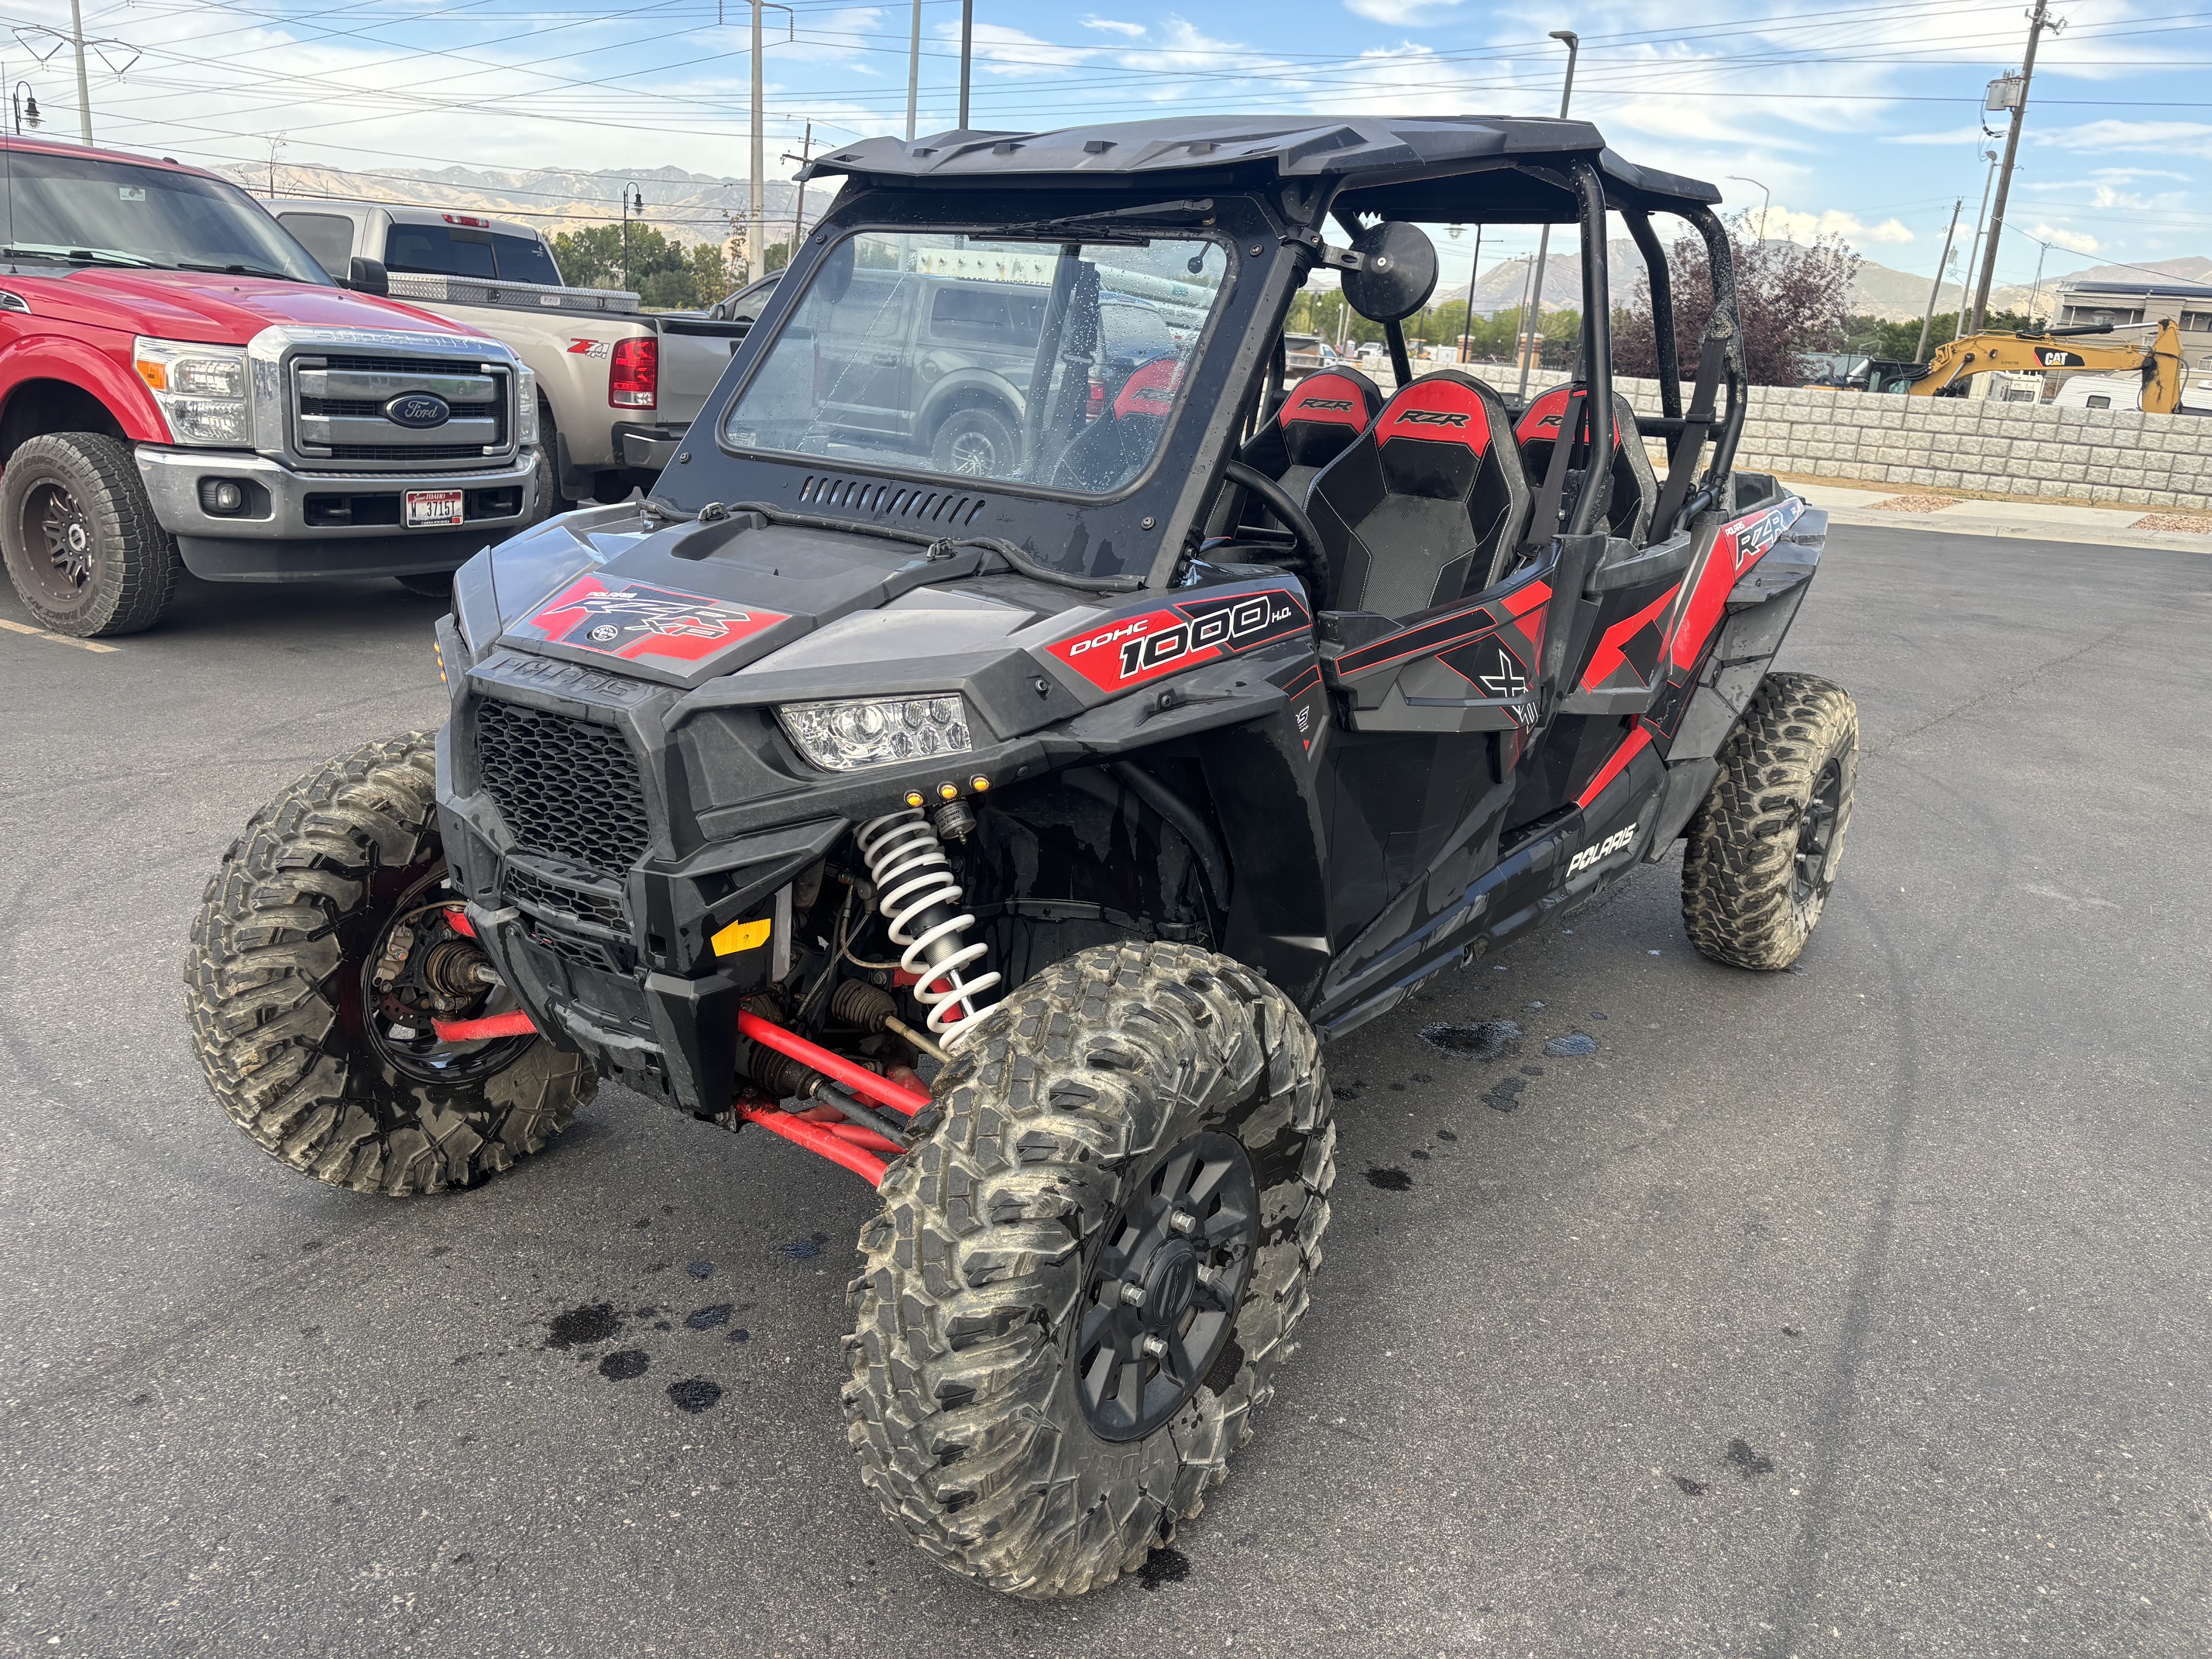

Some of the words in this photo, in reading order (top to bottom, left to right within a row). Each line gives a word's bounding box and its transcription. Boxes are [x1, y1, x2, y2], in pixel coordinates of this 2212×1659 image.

[567, 338, 610, 354] Z71
[2045, 352, 2068, 366] CAT
[404, 400, 438, 420] Ford
[1297, 397, 1355, 413] RZR
[1395, 409, 1472, 428] RZR
[427, 500, 455, 517] 3715T
[1724, 520, 1745, 538] POLARIS
[1735, 509, 1787, 571] RZR
[540, 597, 751, 631] RZR
[624, 618, 730, 640] XP
[1069, 619, 1149, 657] DOHC
[1119, 595, 1270, 680] 1000
[1271, 606, 1292, 624] H.O.
[491, 657, 640, 699] POLARIS
[1565, 822, 1637, 878] POLARIS
